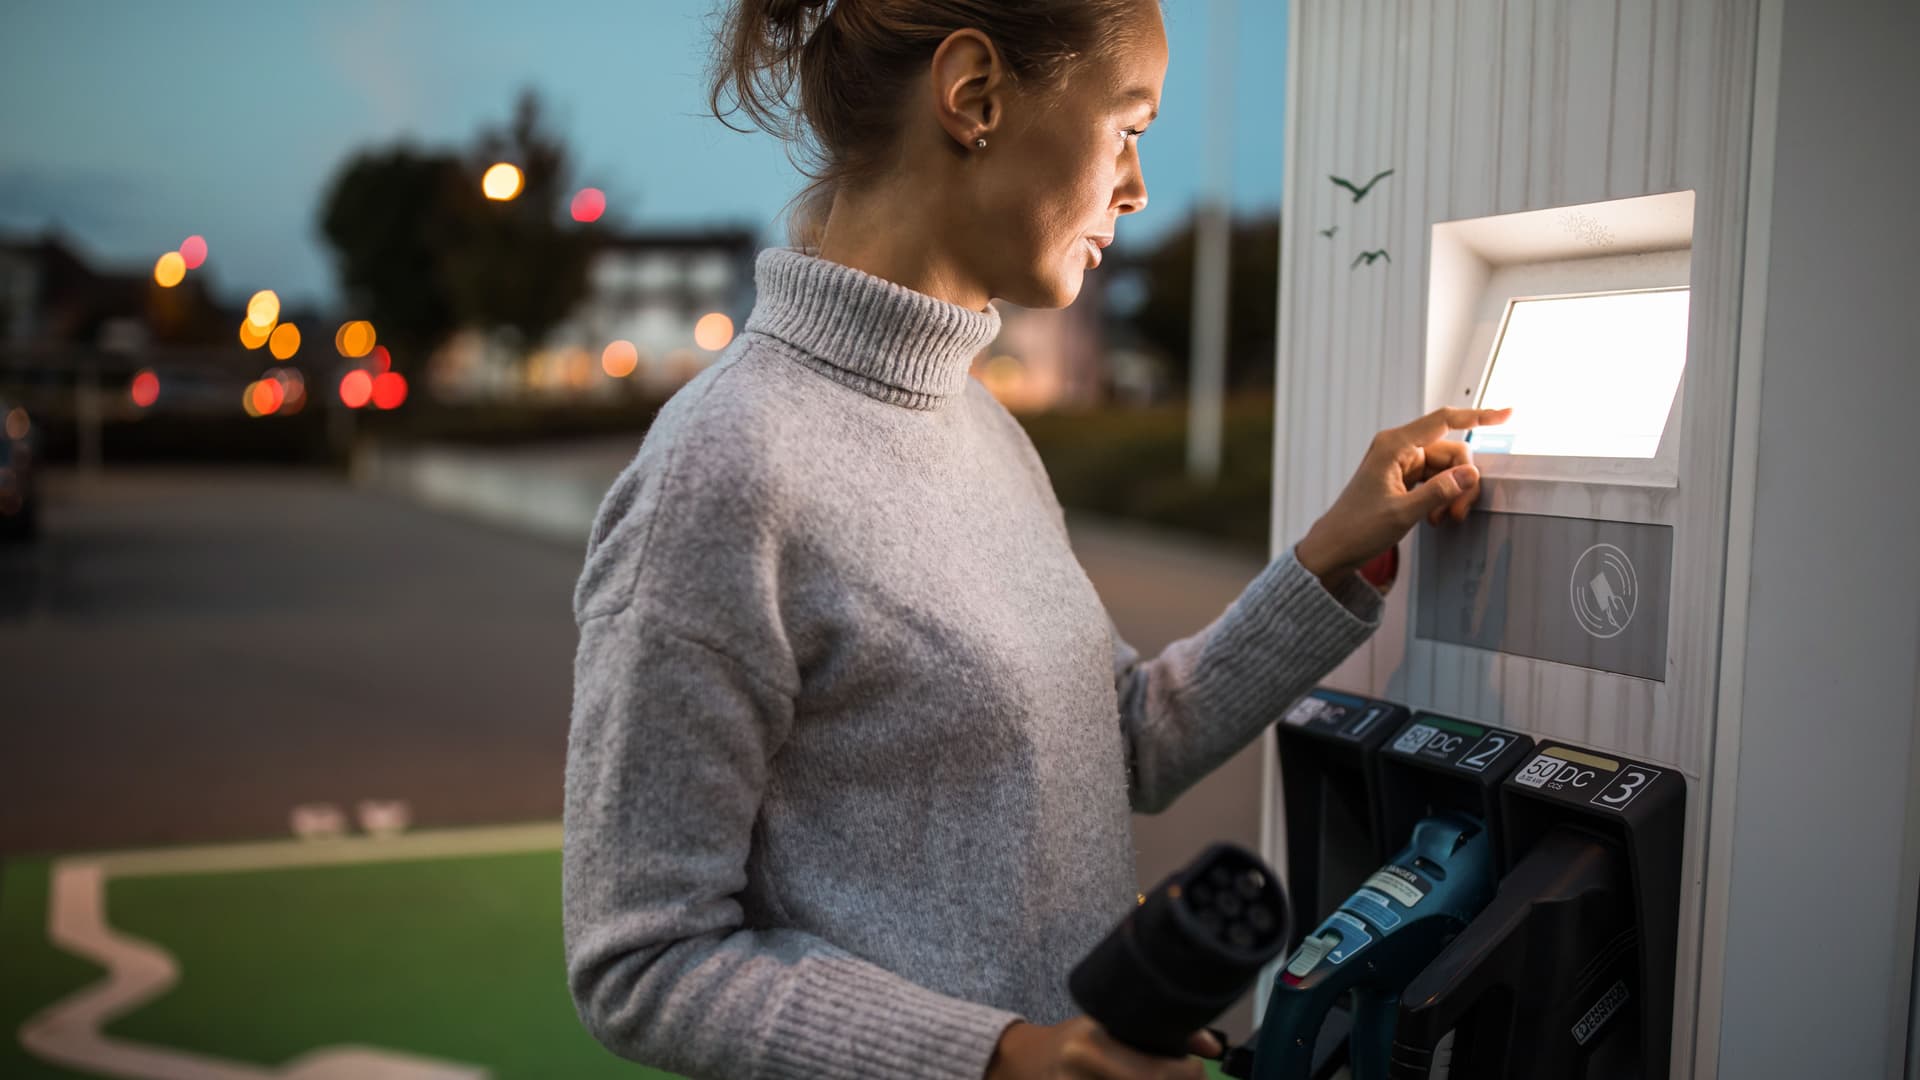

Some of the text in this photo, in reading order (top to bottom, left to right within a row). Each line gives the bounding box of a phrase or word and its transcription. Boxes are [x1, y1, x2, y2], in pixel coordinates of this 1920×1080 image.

[1351, 708, 1379, 735] 1
[1427, 732, 1462, 752] DC
[1465, 737, 1505, 766] 2
[1527, 759, 1558, 778] 50
[1554, 766, 1596, 788] DC
[1601, 772, 1646, 803] 3
